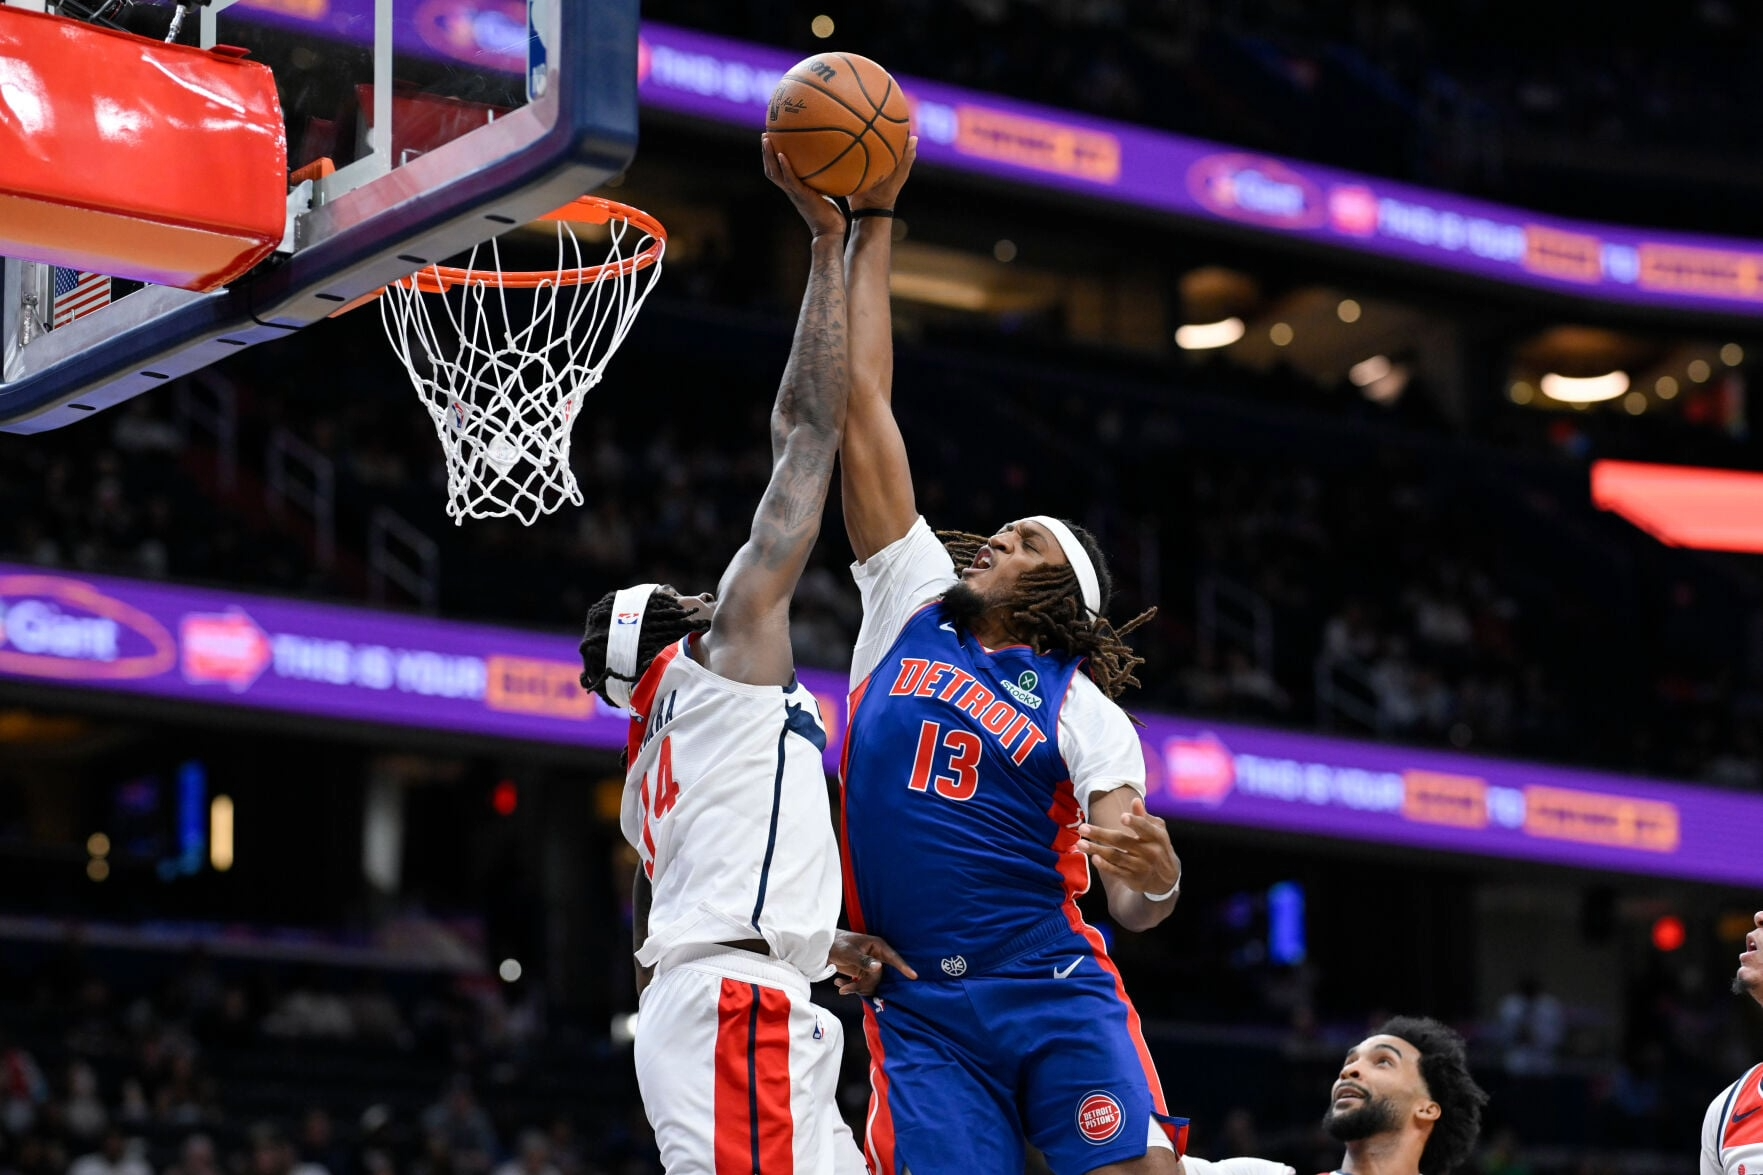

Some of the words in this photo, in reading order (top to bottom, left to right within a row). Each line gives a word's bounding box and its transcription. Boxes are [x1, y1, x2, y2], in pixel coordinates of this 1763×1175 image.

[889, 658, 1047, 766] DETROIT
[908, 720, 982, 801] 13
[1083, 1105, 1112, 1121] DETROIT
[1085, 1113, 1115, 1130] PISTONS
